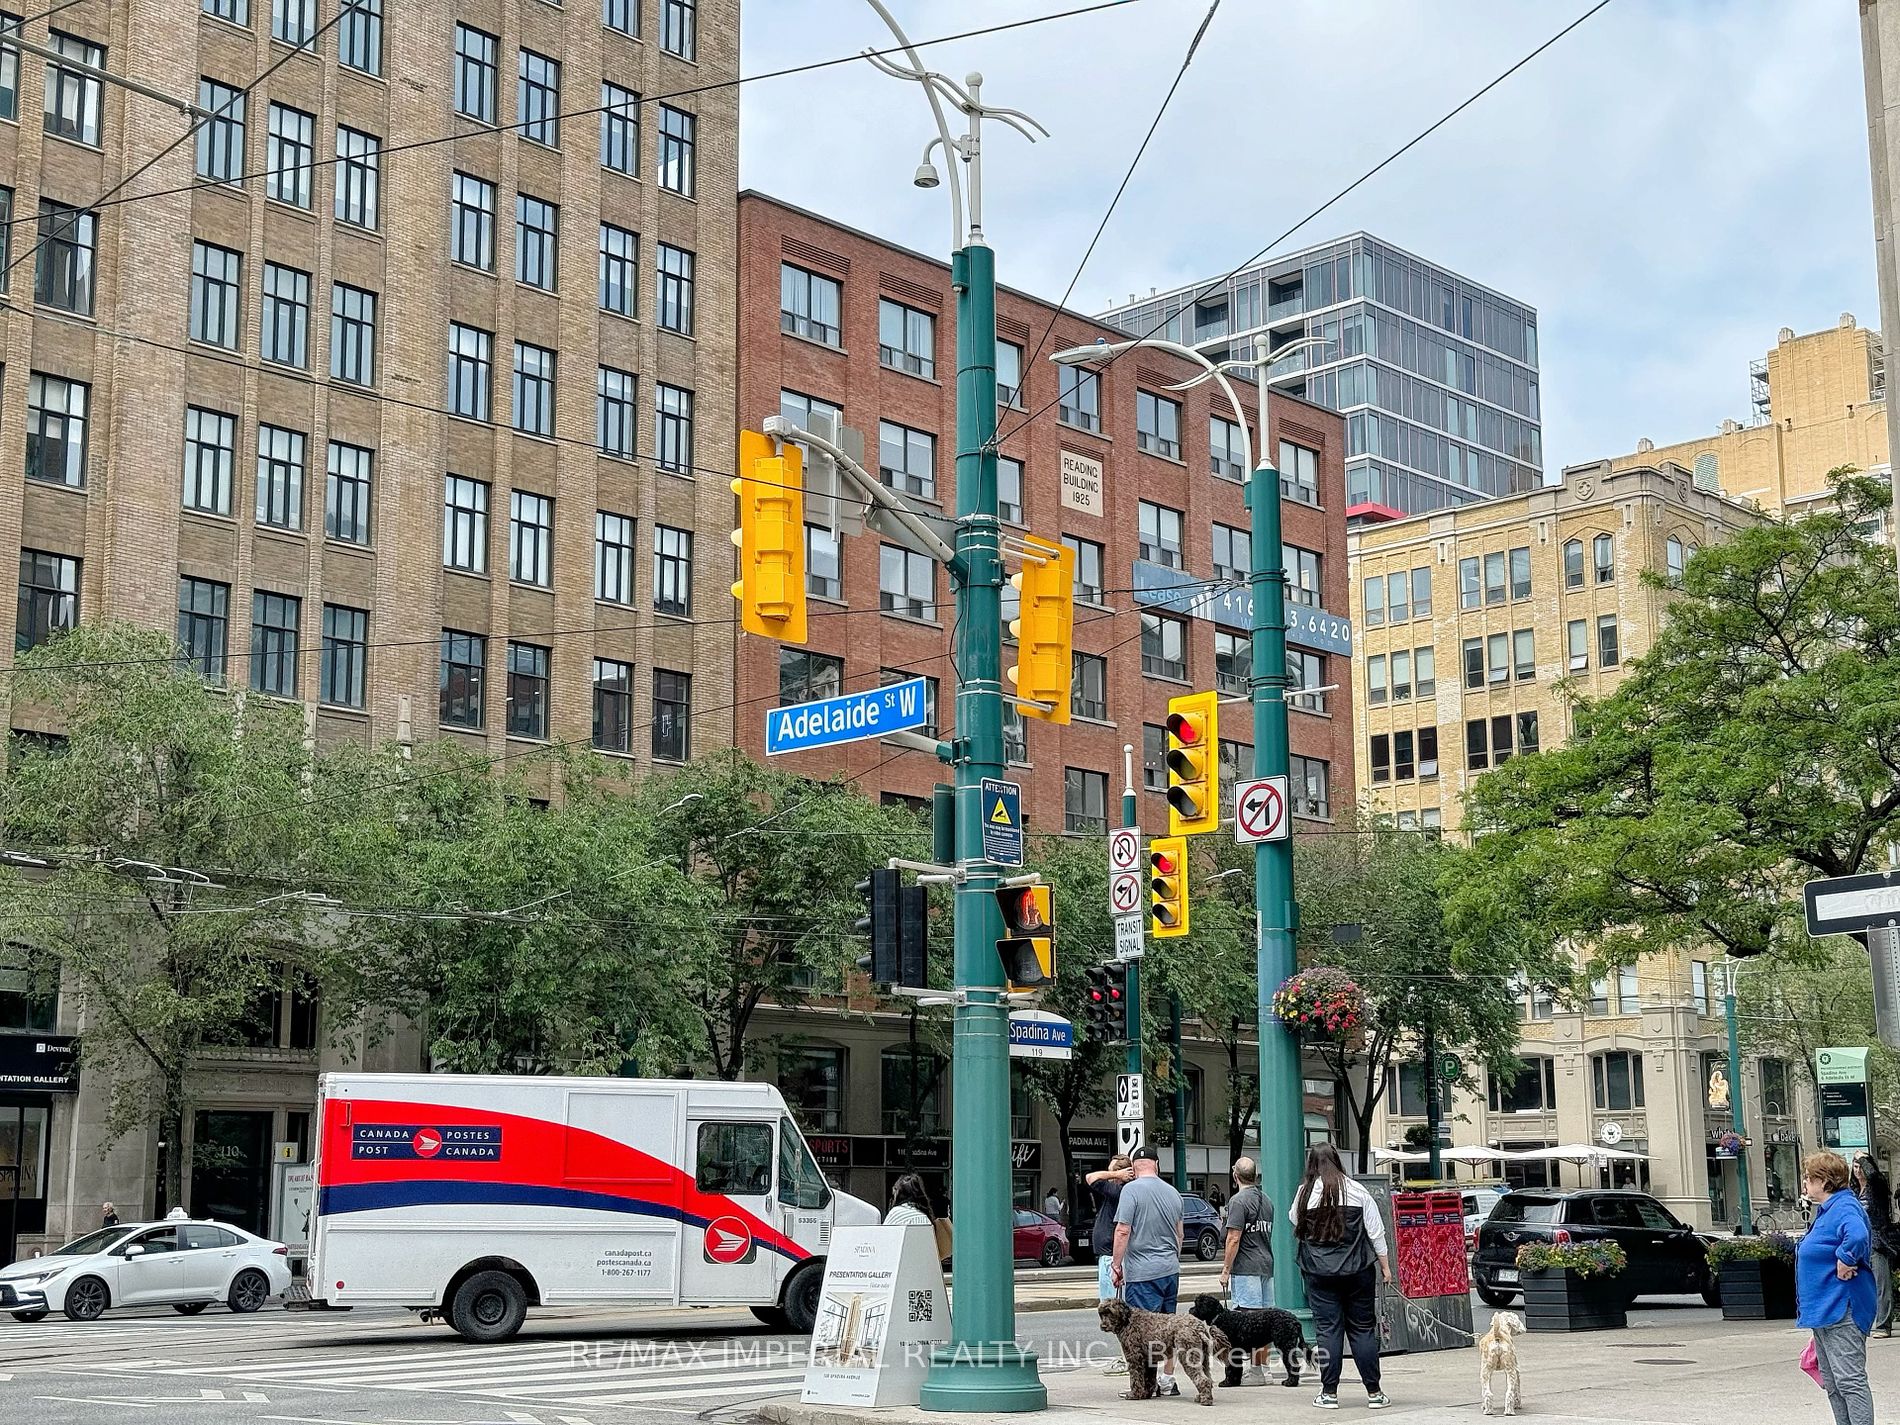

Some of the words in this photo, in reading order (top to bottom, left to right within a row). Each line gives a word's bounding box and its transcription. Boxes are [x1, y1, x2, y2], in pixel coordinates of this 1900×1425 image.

[1064, 457, 1098, 478] READING
[1063, 472, 1099, 494] BUILDING
[1072, 491, 1091, 506] 1925
[777, 698, 881, 742] Adelaide
[884, 691, 897, 709] St
[899, 685, 917, 718] W
[984, 782, 1018, 796] ATTENTION
[1117, 919, 1141, 937] TRANSIT
[1119, 937, 1141, 954] SIGNAL
[1009, 1022, 1049, 1042] Spadina
[1051, 1028, 1066, 1042] Ave
[47, 1045, 71, 1053] Devron
[1031, 1048, 1043, 1057] 119
[33, 1076, 69, 1084] GALLERY
[360, 1129, 410, 1139] CANADA
[446, 1131, 490, 1140] POSTES
[358, 1146, 389, 1155] POST
[809, 1140, 849, 1153] SPORTS
[445, 1147, 495, 1156] CANADA
[604, 1249, 652, 1258] canadapost.ca
[596, 1259, 652, 1267] postescanada.ca
[601, 1269, 651, 1277] 1-800-267-1177
[829, 1271, 868, 1279] PRESENTATION
[868, 1271, 892, 1279] GALLERY
